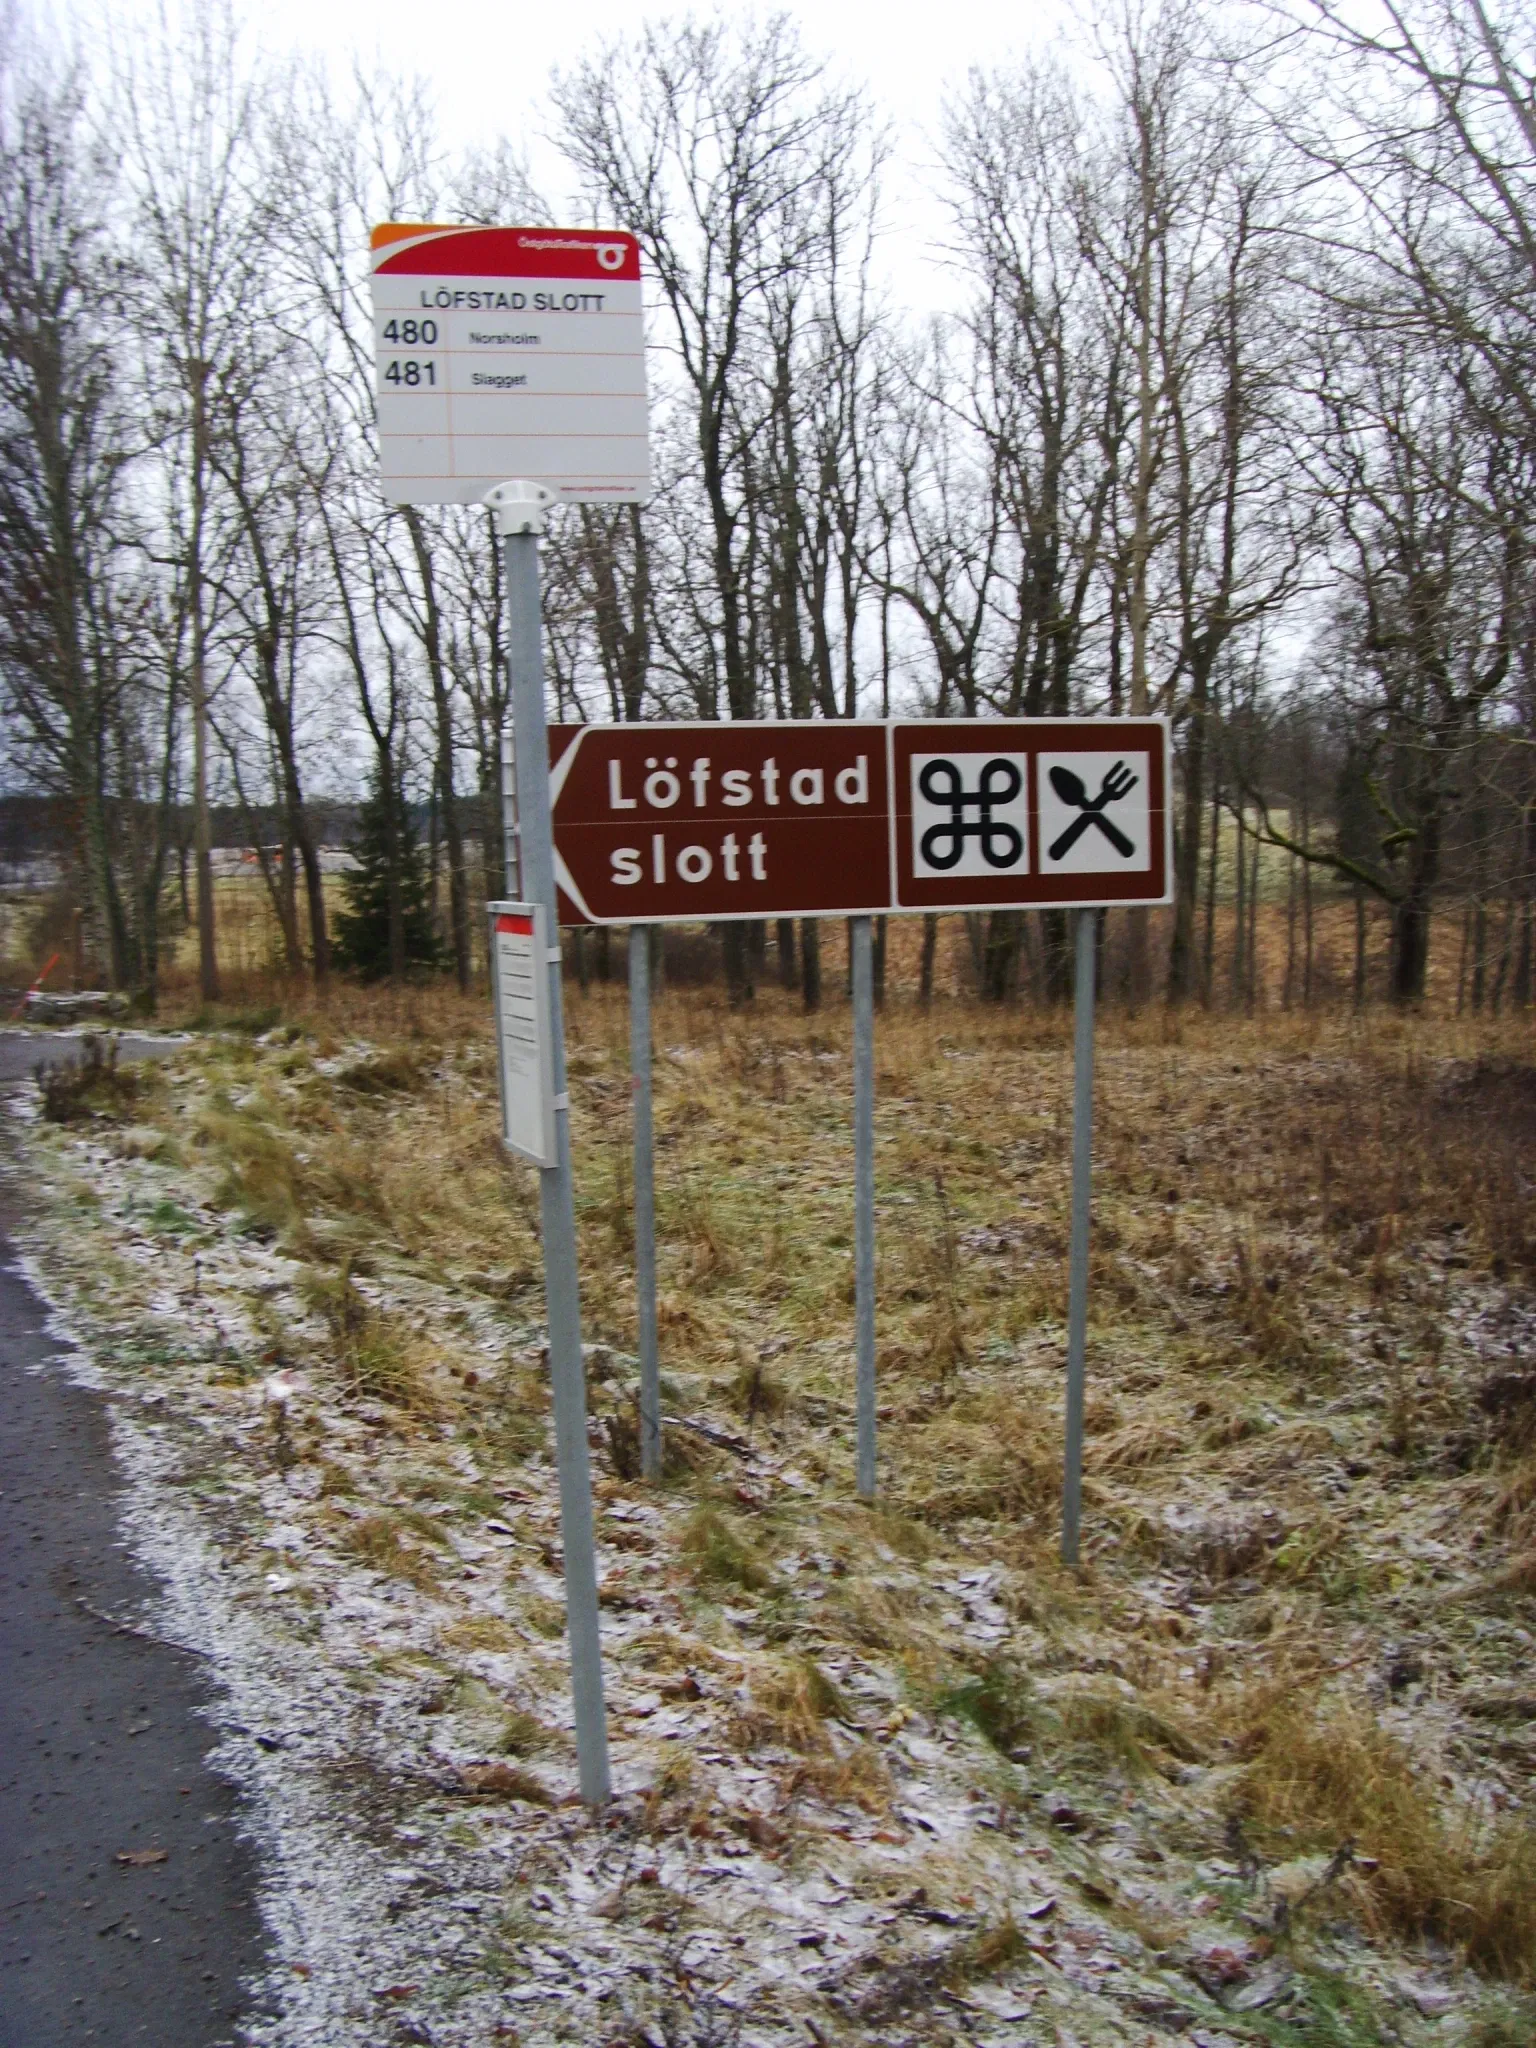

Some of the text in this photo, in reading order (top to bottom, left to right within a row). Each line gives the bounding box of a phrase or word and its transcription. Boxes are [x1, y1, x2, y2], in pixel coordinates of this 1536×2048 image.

[420, 286, 605, 312] LÖFSTAD SLOTT
[383, 319, 541, 345] 480 Norsholm
[385, 361, 437, 386] 481
[608, 755, 869, 809] Löfstad
[609, 832, 767, 885] slott
